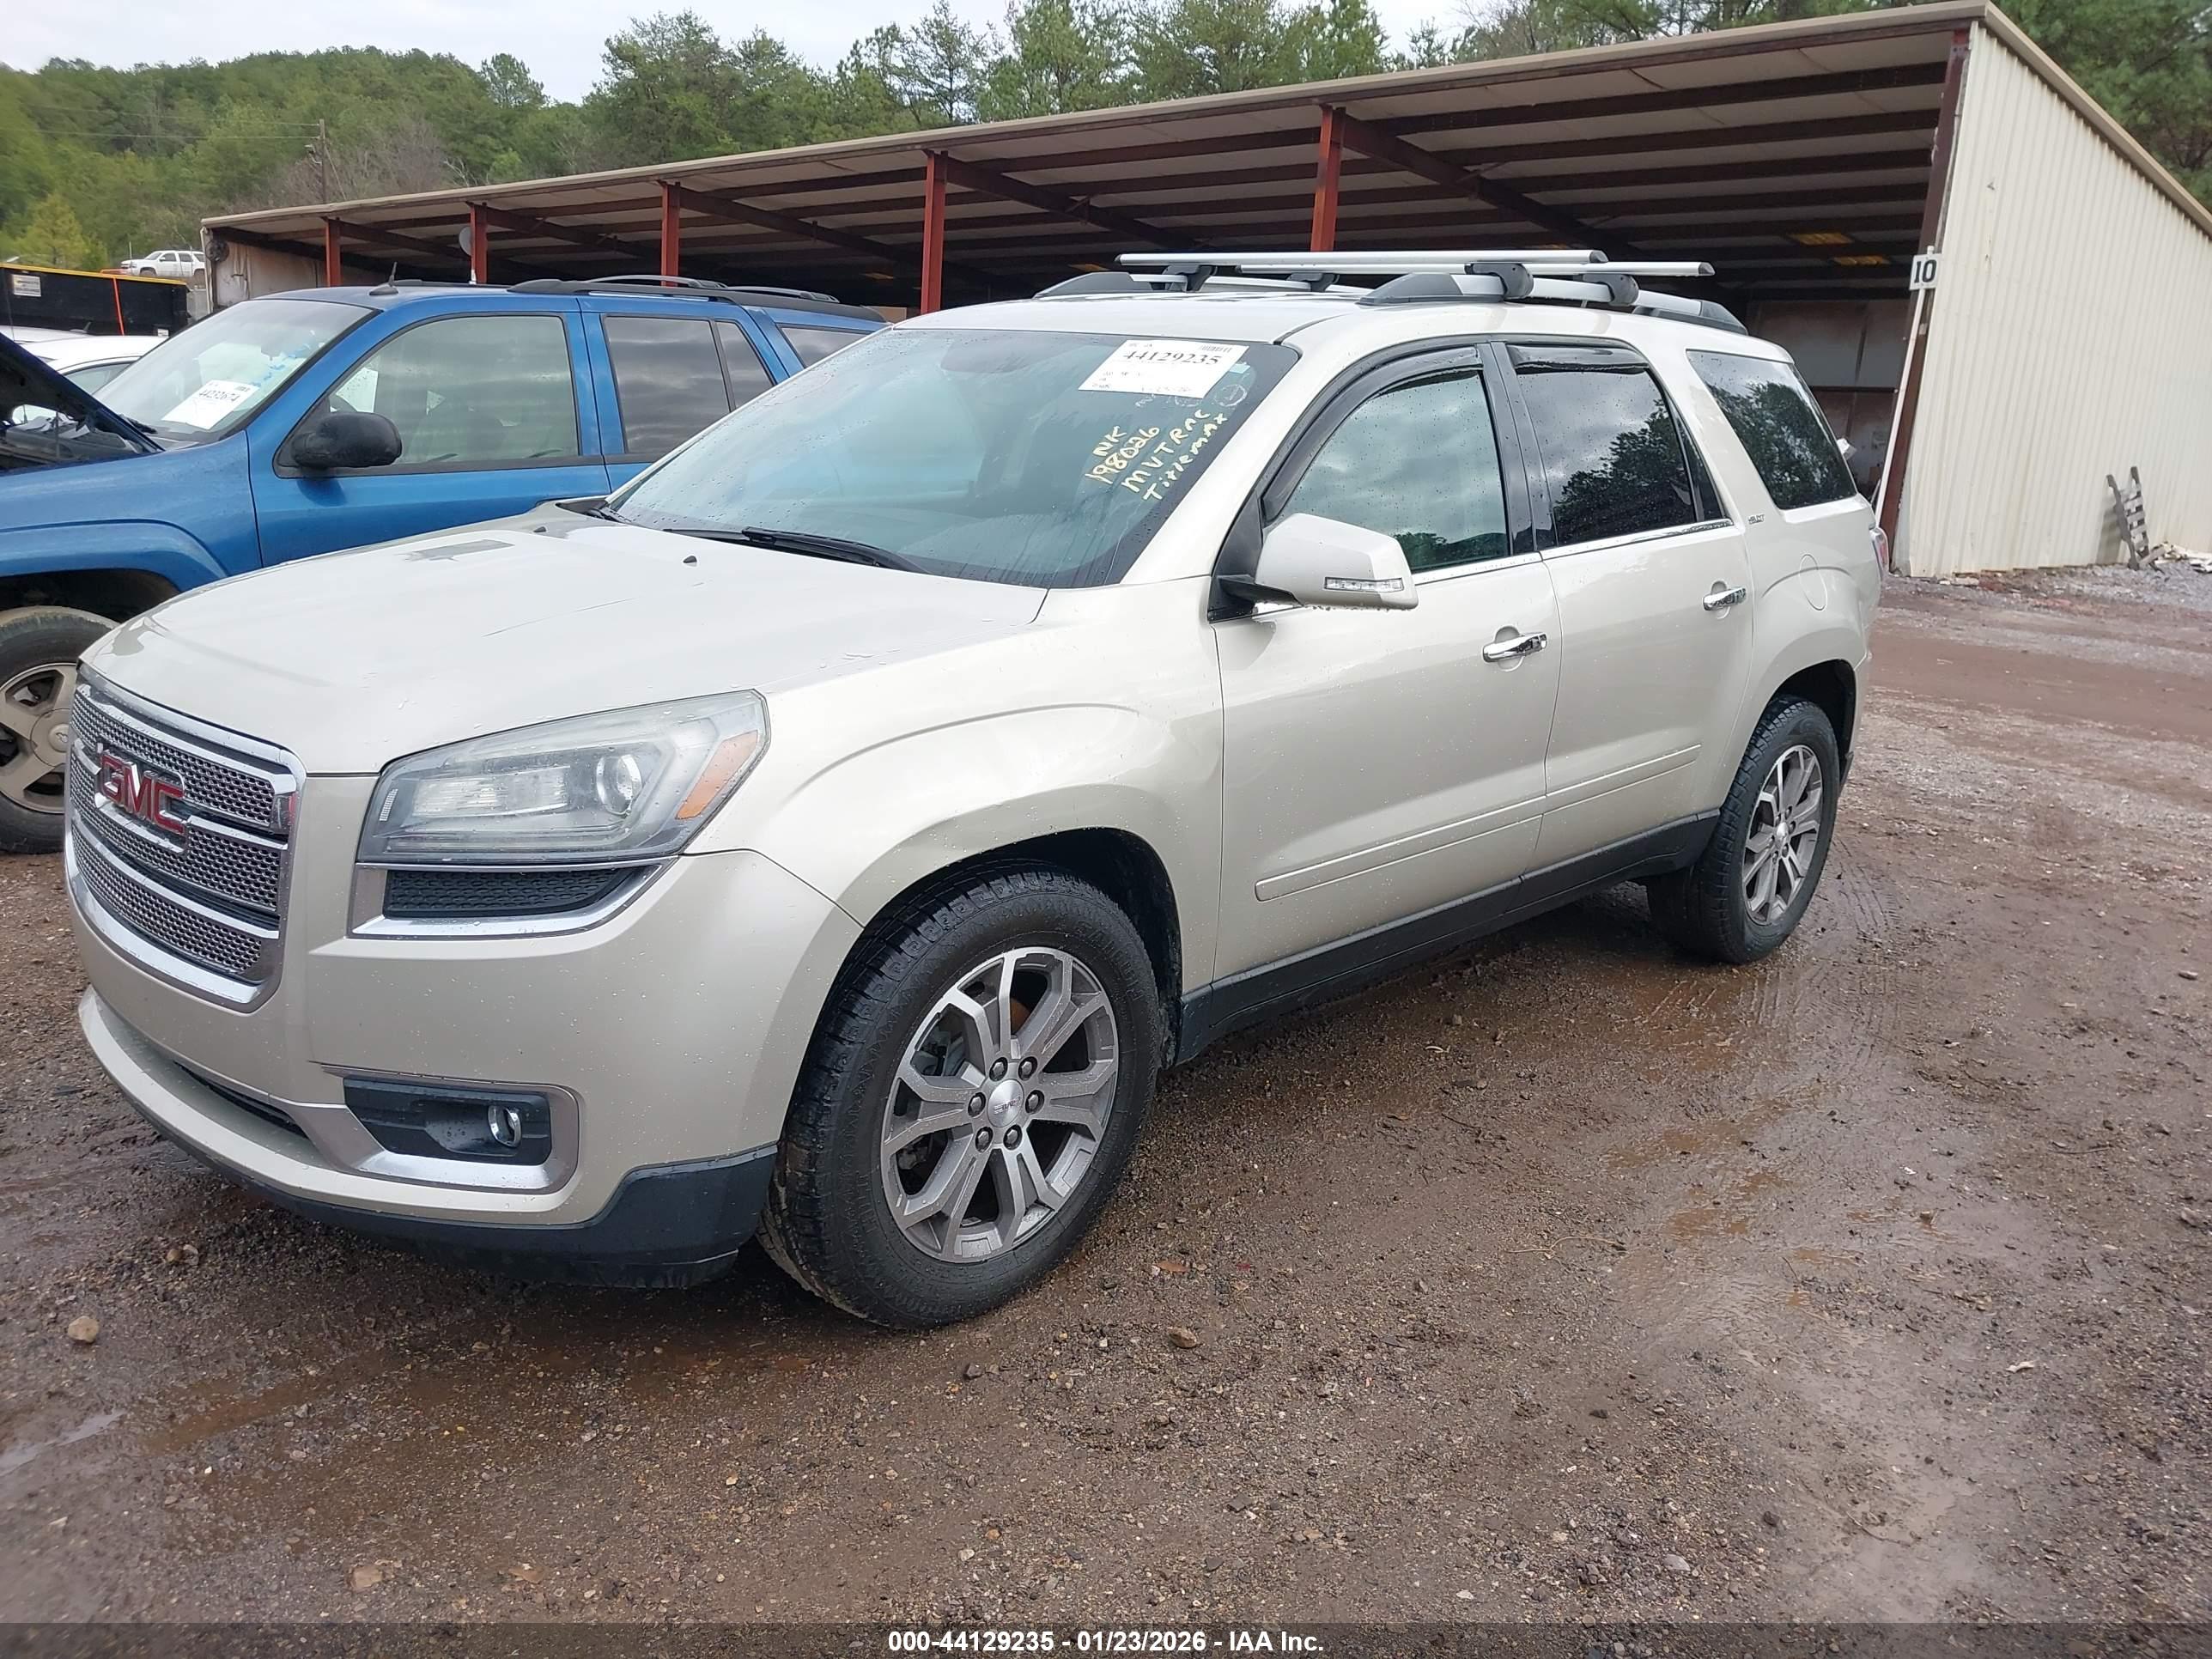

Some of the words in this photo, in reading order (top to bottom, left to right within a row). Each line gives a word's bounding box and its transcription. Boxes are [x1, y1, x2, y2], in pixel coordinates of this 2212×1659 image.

[1914, 259, 1937, 283] 10
[1123, 349, 1222, 365] 44129235
[100, 752, 186, 835] GMC
